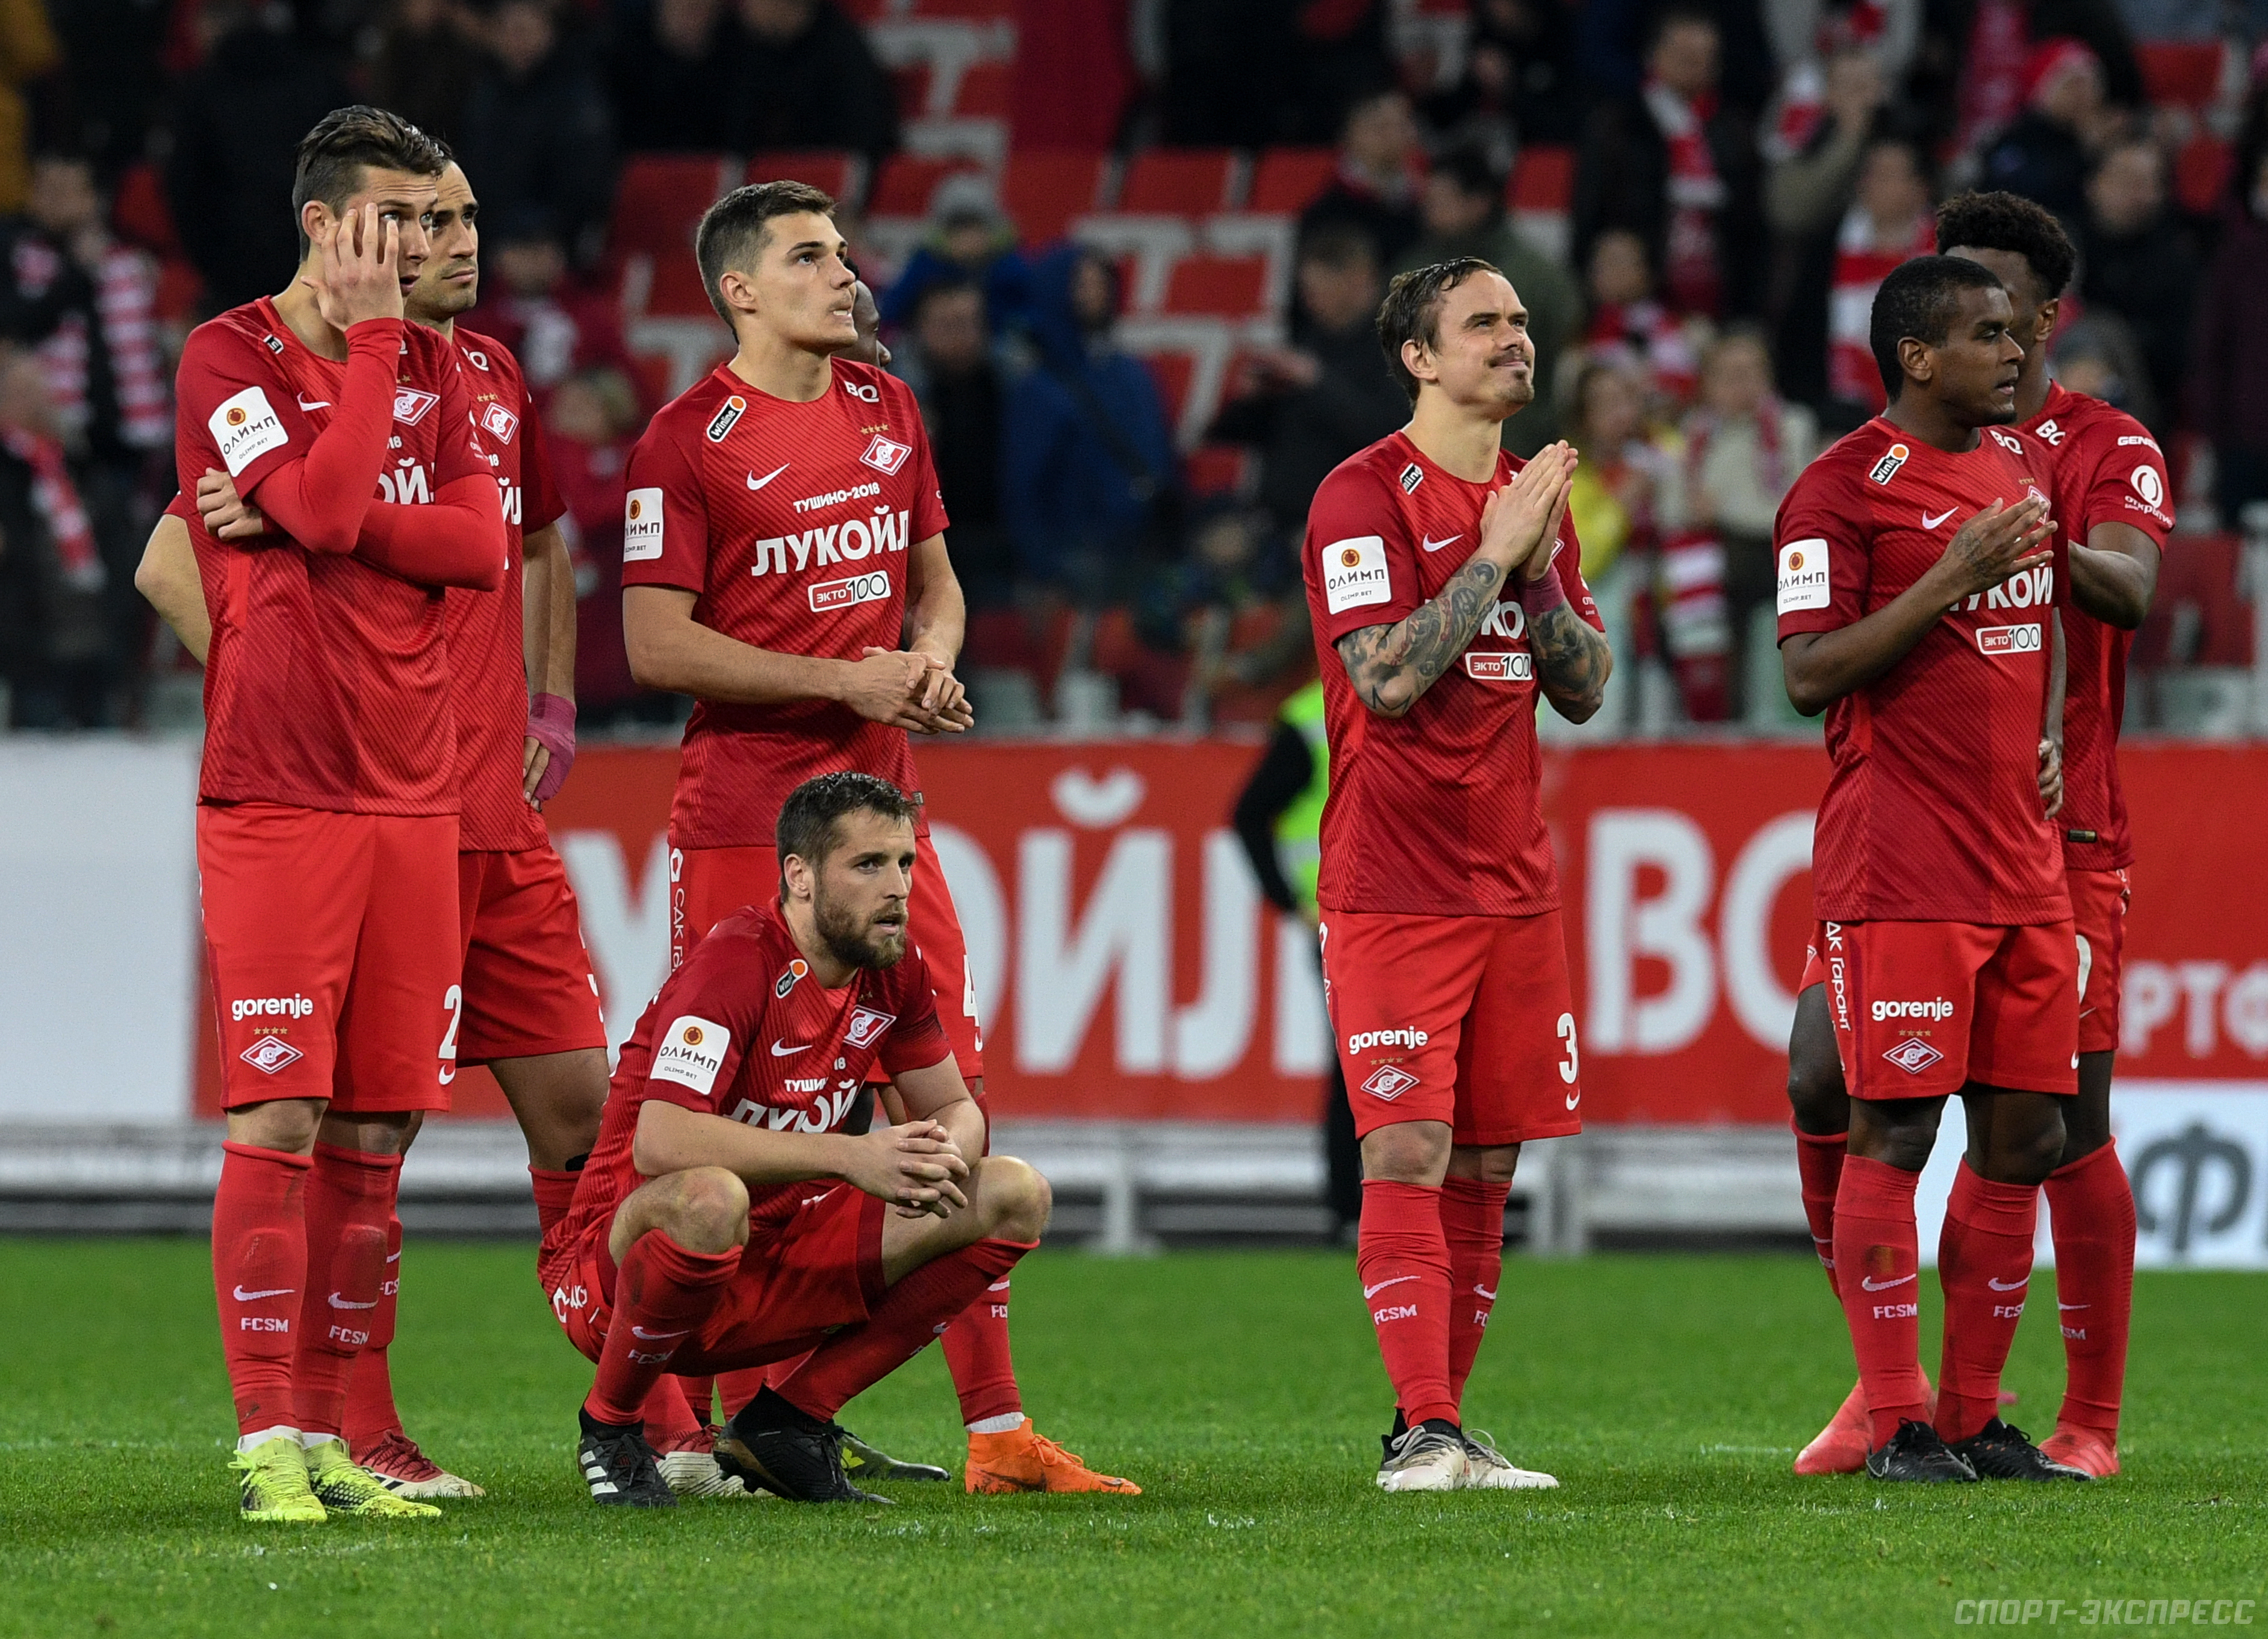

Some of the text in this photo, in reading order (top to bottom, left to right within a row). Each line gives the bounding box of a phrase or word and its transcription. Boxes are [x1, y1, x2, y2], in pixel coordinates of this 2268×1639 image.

[844, 381, 879, 402] BQ
[223, 416, 276, 455] ОЛИМП
[711, 410, 736, 436] Winline
[1990, 429, 2022, 455] BQ
[793, 482, 880, 513] ТУШИНО-2018
[625, 522, 660, 536] ИМП
[751, 505, 909, 576] ЛУКОЙЛ
[816, 574, 887, 603] ЭКТО 100
[1329, 569, 1385, 590] ОЛИМП
[1984, 626, 2039, 648] ЭКТО 100
[1474, 662, 1500, 671] ЭКТО
[1825, 921, 1842, 951] АК
[232, 993, 313, 1021] gorenje
[1872, 997, 1954, 1022] gorenje
[1349, 1025, 1428, 1055] gorenje
[1557, 1012, 1577, 1084] 3
[660, 1047, 718, 1072] ОЛИМП
[1374, 1304, 1417, 1326] FCSM
[1873, 1302, 1917, 1319] FCSM
[1993, 1302, 2024, 1318] FCS
[241, 1317, 288, 1333] FCSM
